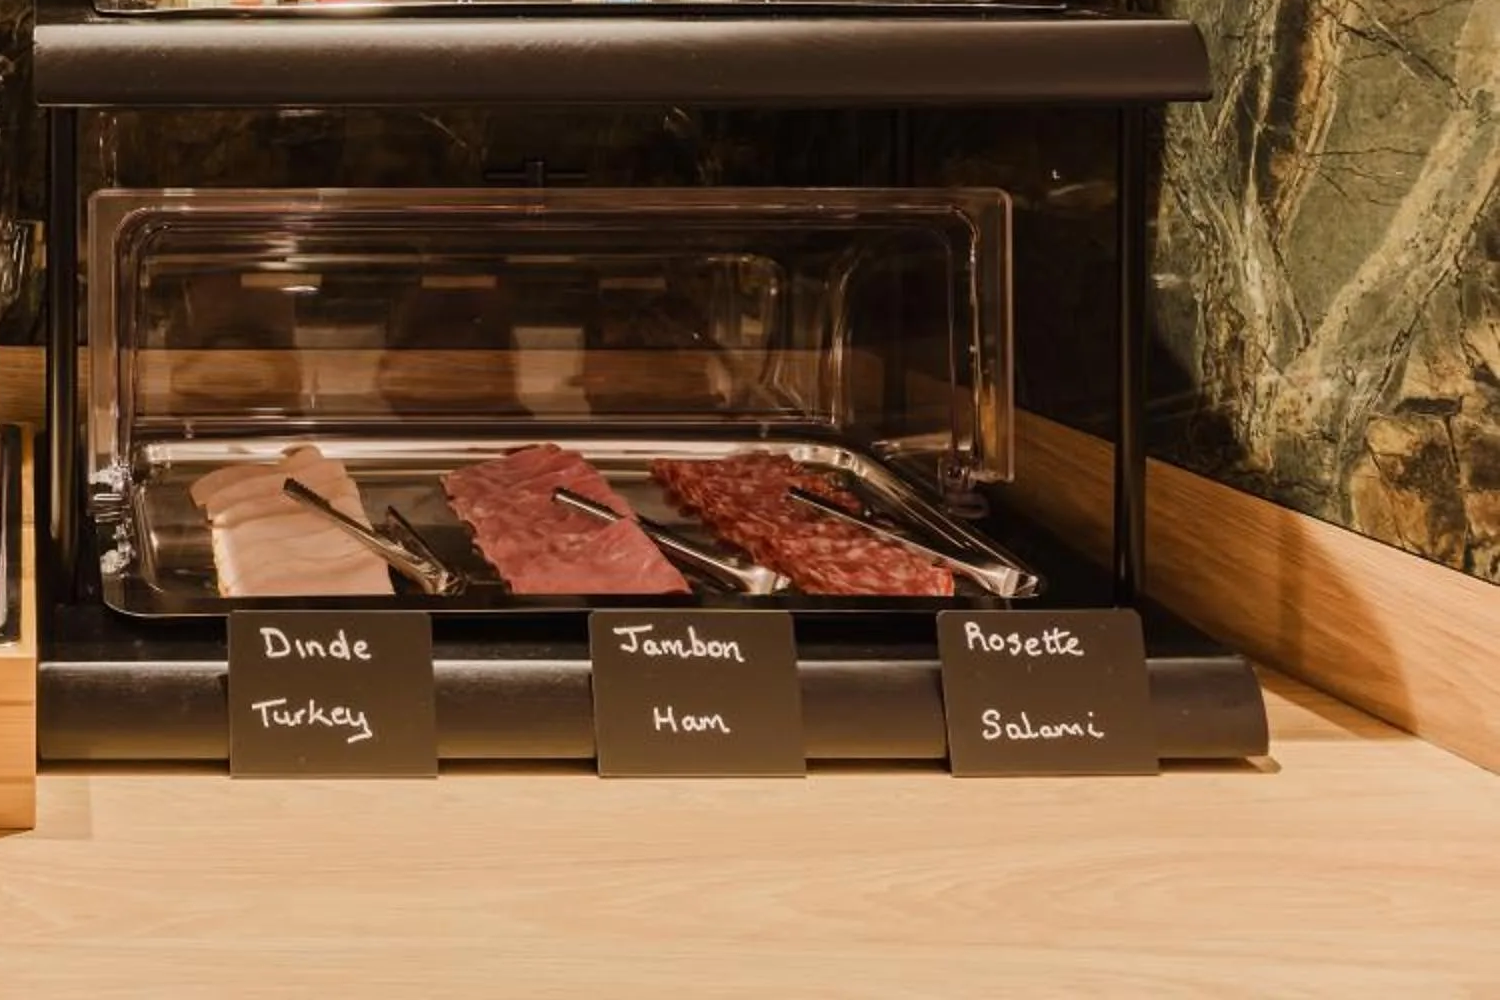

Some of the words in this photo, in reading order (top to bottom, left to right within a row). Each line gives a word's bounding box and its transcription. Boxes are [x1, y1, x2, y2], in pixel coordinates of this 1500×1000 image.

[259, 626, 373, 662] Dinde
[613, 624, 746, 664] Jambon
[963, 620, 1085, 657] Rosette
[251, 698, 374, 744] Turkey
[652, 706, 731, 735] Ham
[981, 708, 1105, 746] Salami
